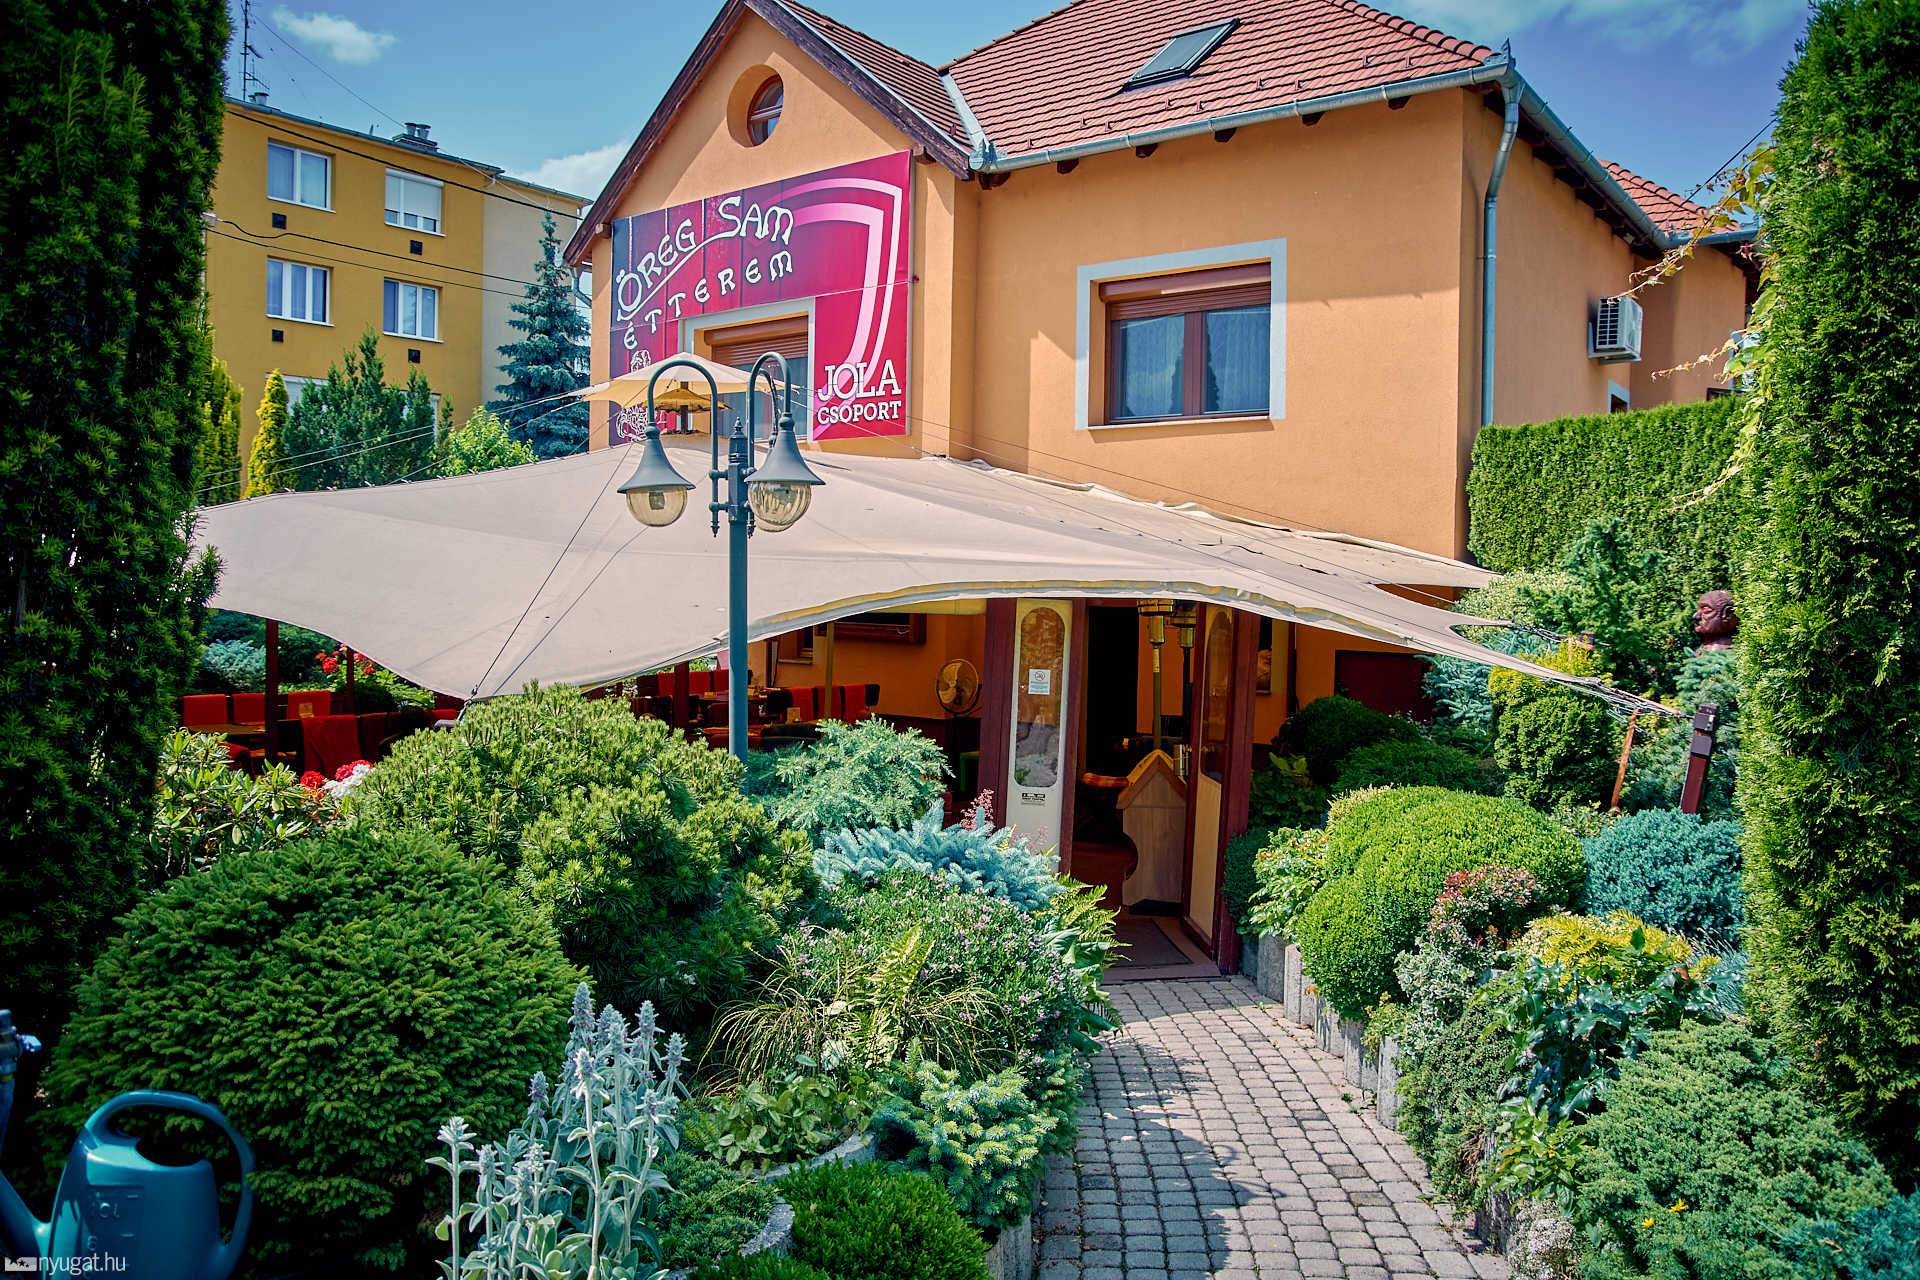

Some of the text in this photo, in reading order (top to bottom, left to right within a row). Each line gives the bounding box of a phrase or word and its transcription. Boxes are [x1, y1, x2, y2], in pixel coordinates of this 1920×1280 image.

[615, 195, 795, 312] ÖREG SAM
[622, 249, 794, 351] ÉTTEREM
[817, 359, 903, 402] JOLA
[817, 400, 903, 425] CSOPORT
